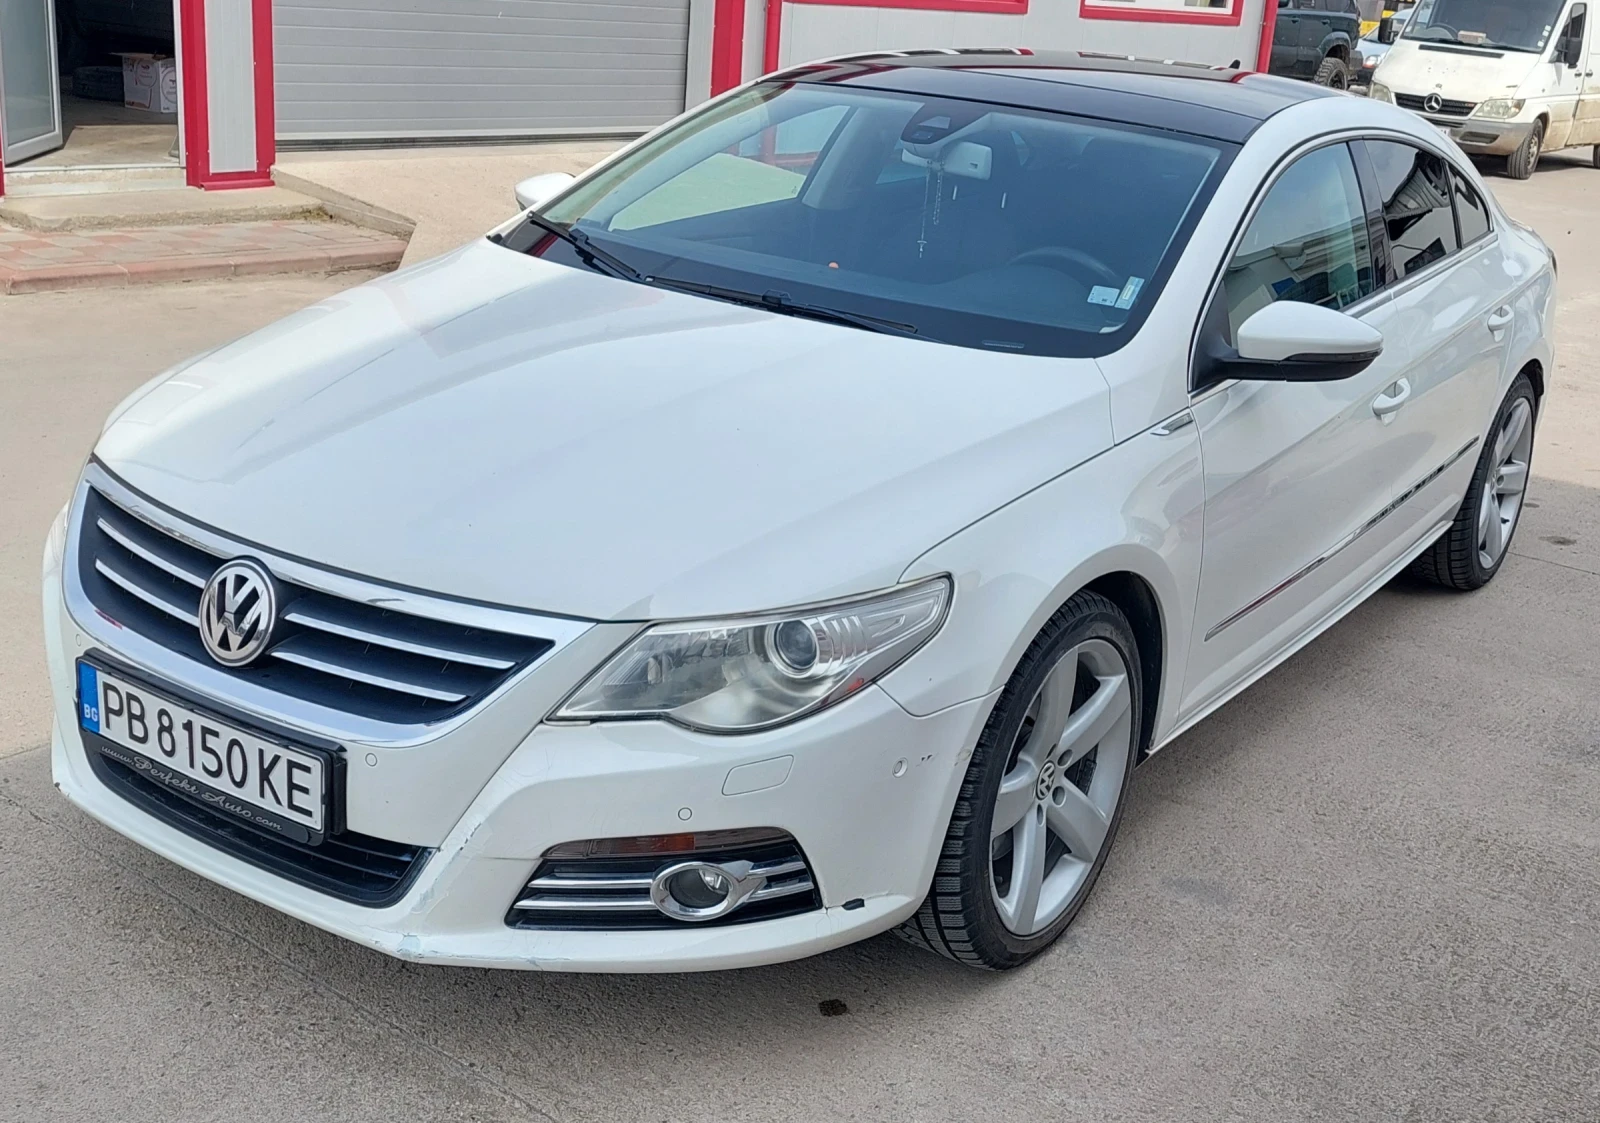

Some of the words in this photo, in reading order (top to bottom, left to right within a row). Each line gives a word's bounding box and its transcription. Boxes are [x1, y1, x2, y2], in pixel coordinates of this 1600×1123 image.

[83, 703, 98, 722] BG
[102, 681, 148, 744] PB
[157, 708, 248, 788] 8150
[258, 748, 313, 818] KE
